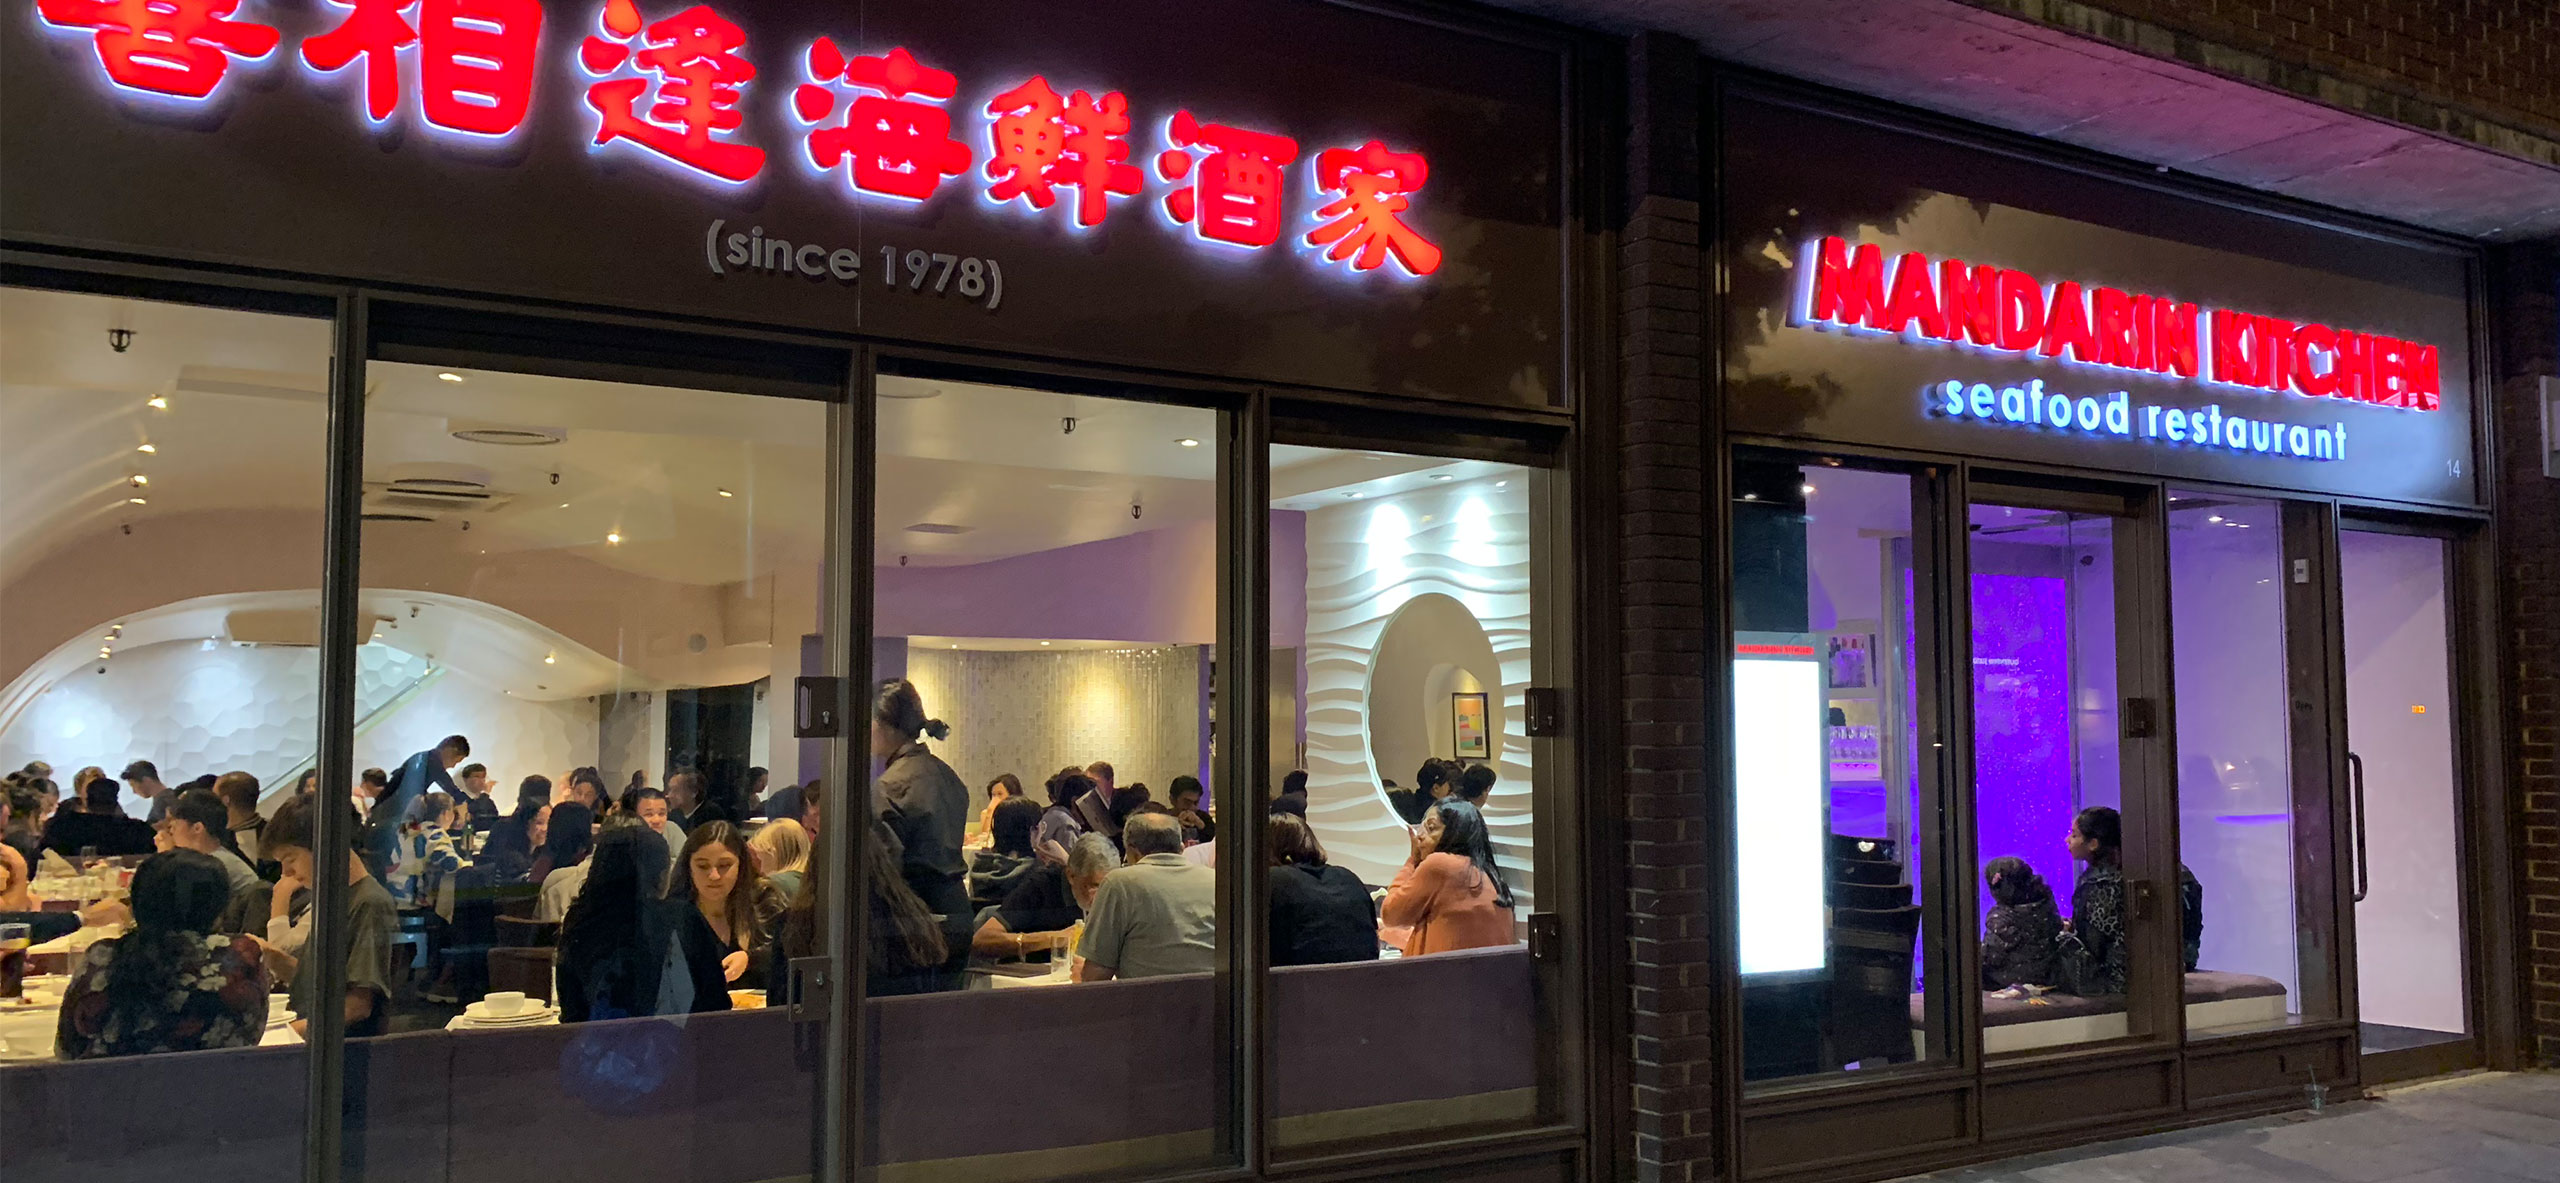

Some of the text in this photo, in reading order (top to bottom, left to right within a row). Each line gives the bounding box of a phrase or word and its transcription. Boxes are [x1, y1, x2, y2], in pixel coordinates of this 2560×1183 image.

[706, 219, 1003, 309] (since 1978)
[1806, 236, 2440, 412] MANDARIN KITCHEN
[1941, 379, 2346, 461] seafood restaurant
[2446, 459, 2461, 478] 14
